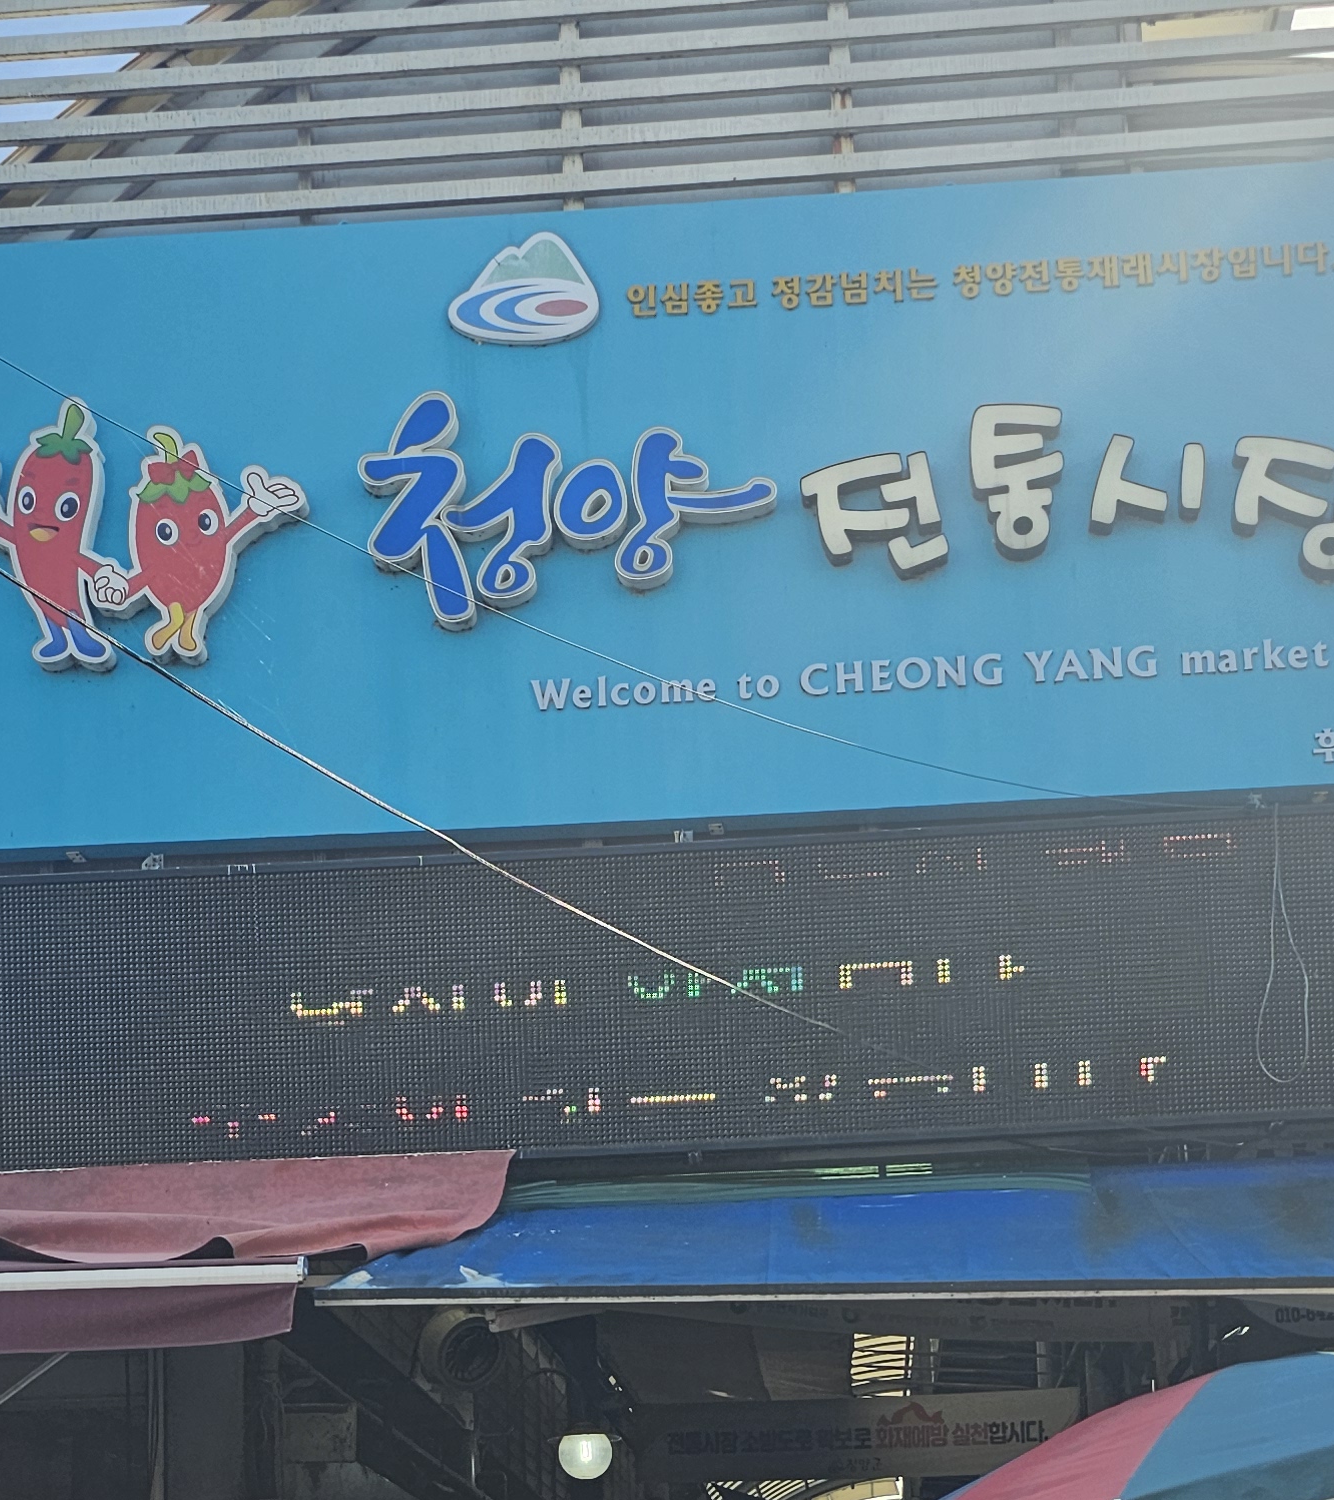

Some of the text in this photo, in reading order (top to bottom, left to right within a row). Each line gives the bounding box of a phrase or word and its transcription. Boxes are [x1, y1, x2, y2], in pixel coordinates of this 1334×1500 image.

[626, 277, 759, 319] 인심좋고
[771, 267, 940, 311] 정감넘치는
[357, 391, 778, 631] 청양
[531, 638, 1330, 711] Welcome to CHEONG YANG market
[875, 1423, 949, 1449] 화재예방
[952, 1420, 1049, 1447] 실천합시다.
